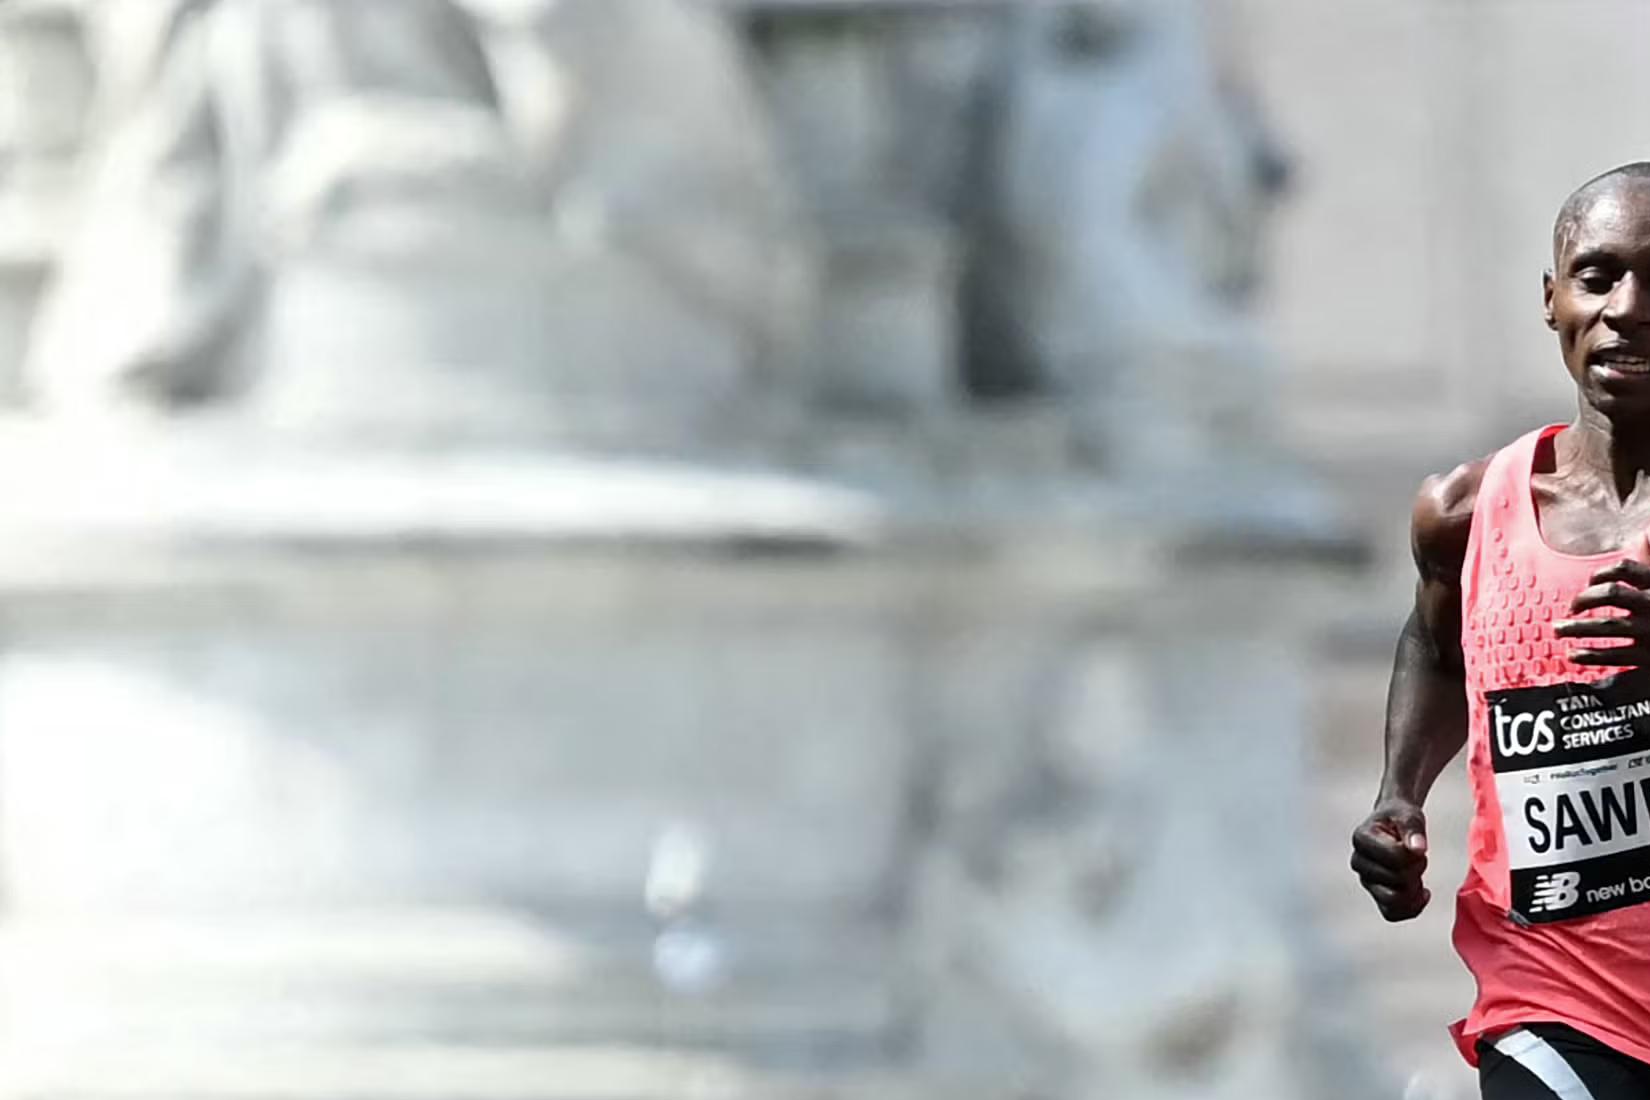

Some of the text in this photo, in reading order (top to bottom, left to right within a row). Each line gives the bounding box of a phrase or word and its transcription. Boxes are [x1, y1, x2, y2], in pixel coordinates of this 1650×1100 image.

[1493, 698, 1555, 757] tcs
[1562, 723, 1634, 750] SERVICES
[1585, 880, 1626, 903] new
